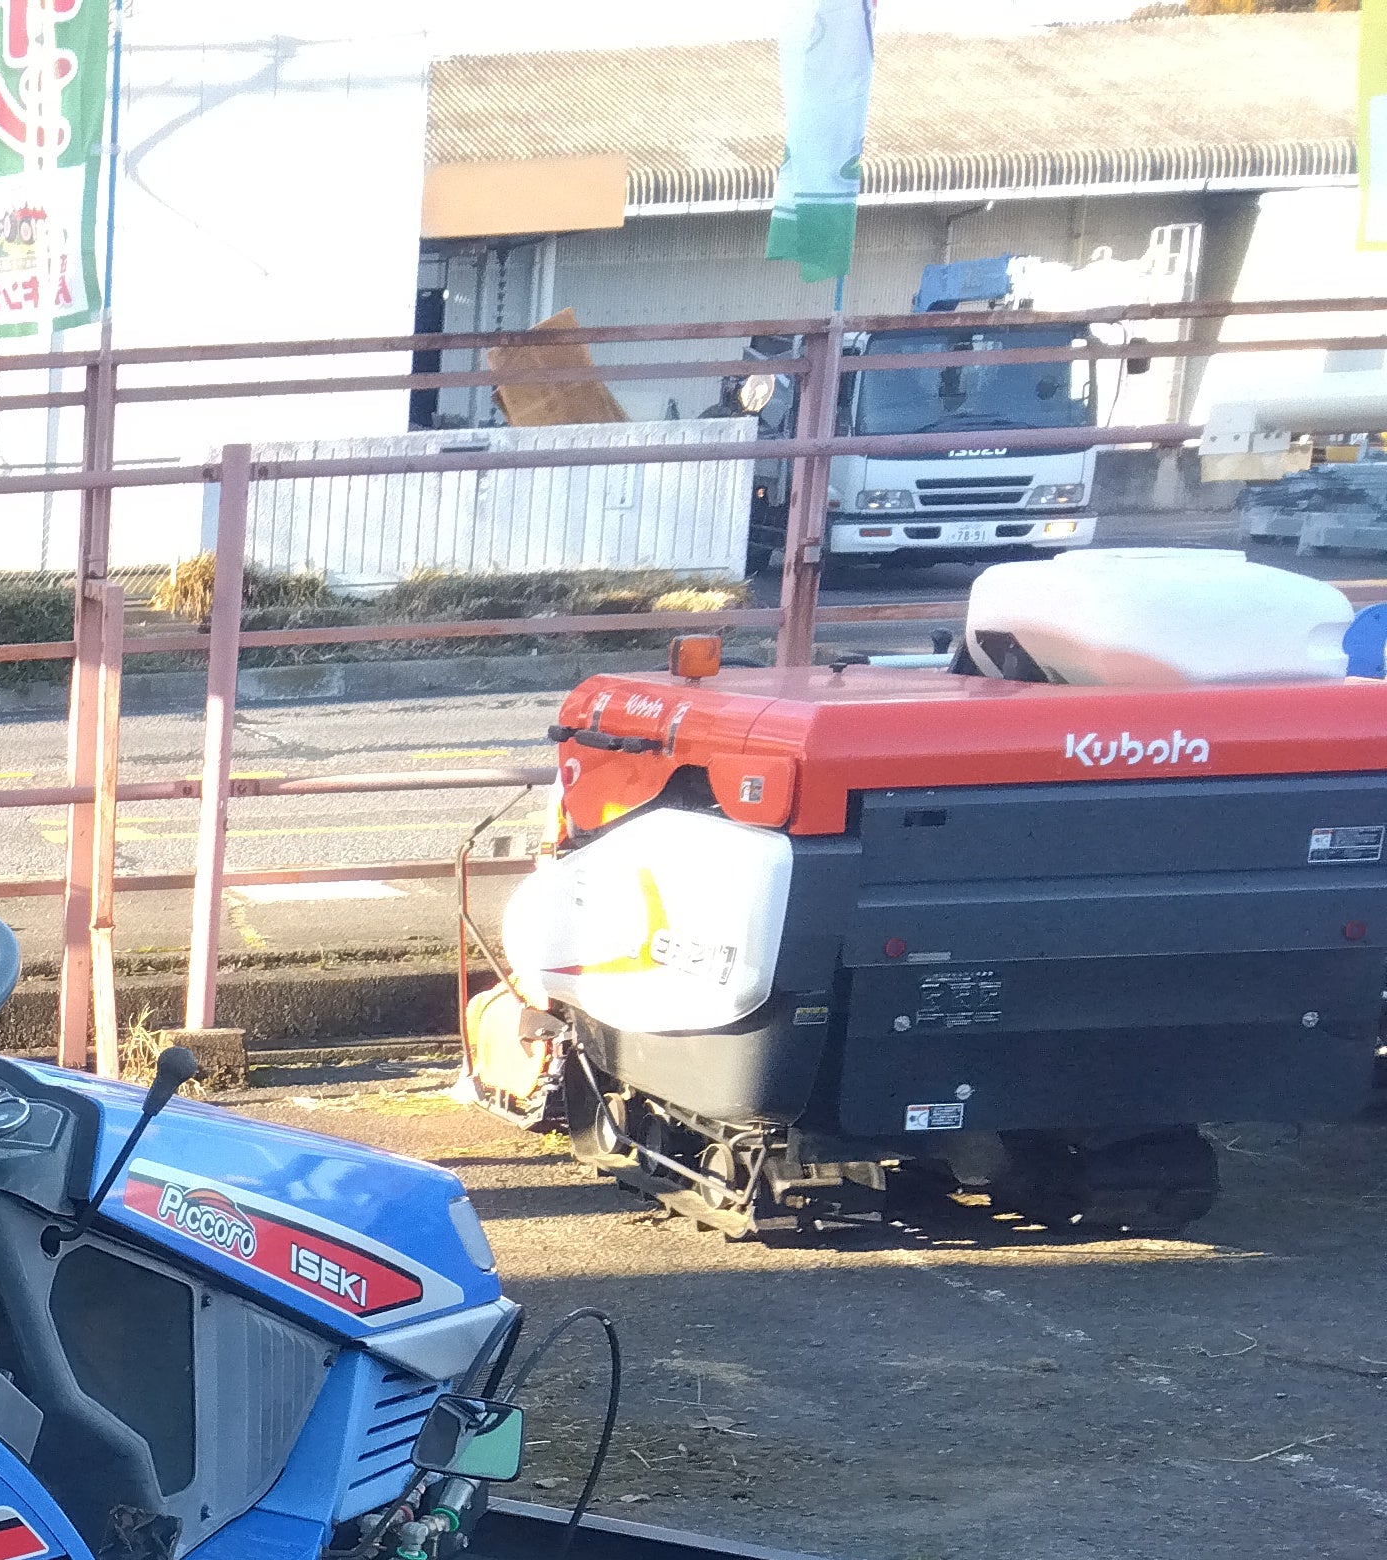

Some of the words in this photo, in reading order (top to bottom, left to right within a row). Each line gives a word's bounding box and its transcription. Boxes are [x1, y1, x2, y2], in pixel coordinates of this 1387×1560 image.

[624, 692, 664, 719] Kubota
[1064, 729, 1210, 767] Kubota
[157, 1182, 258, 1261] Piccoro
[290, 1242, 367, 1308] ISEKI
